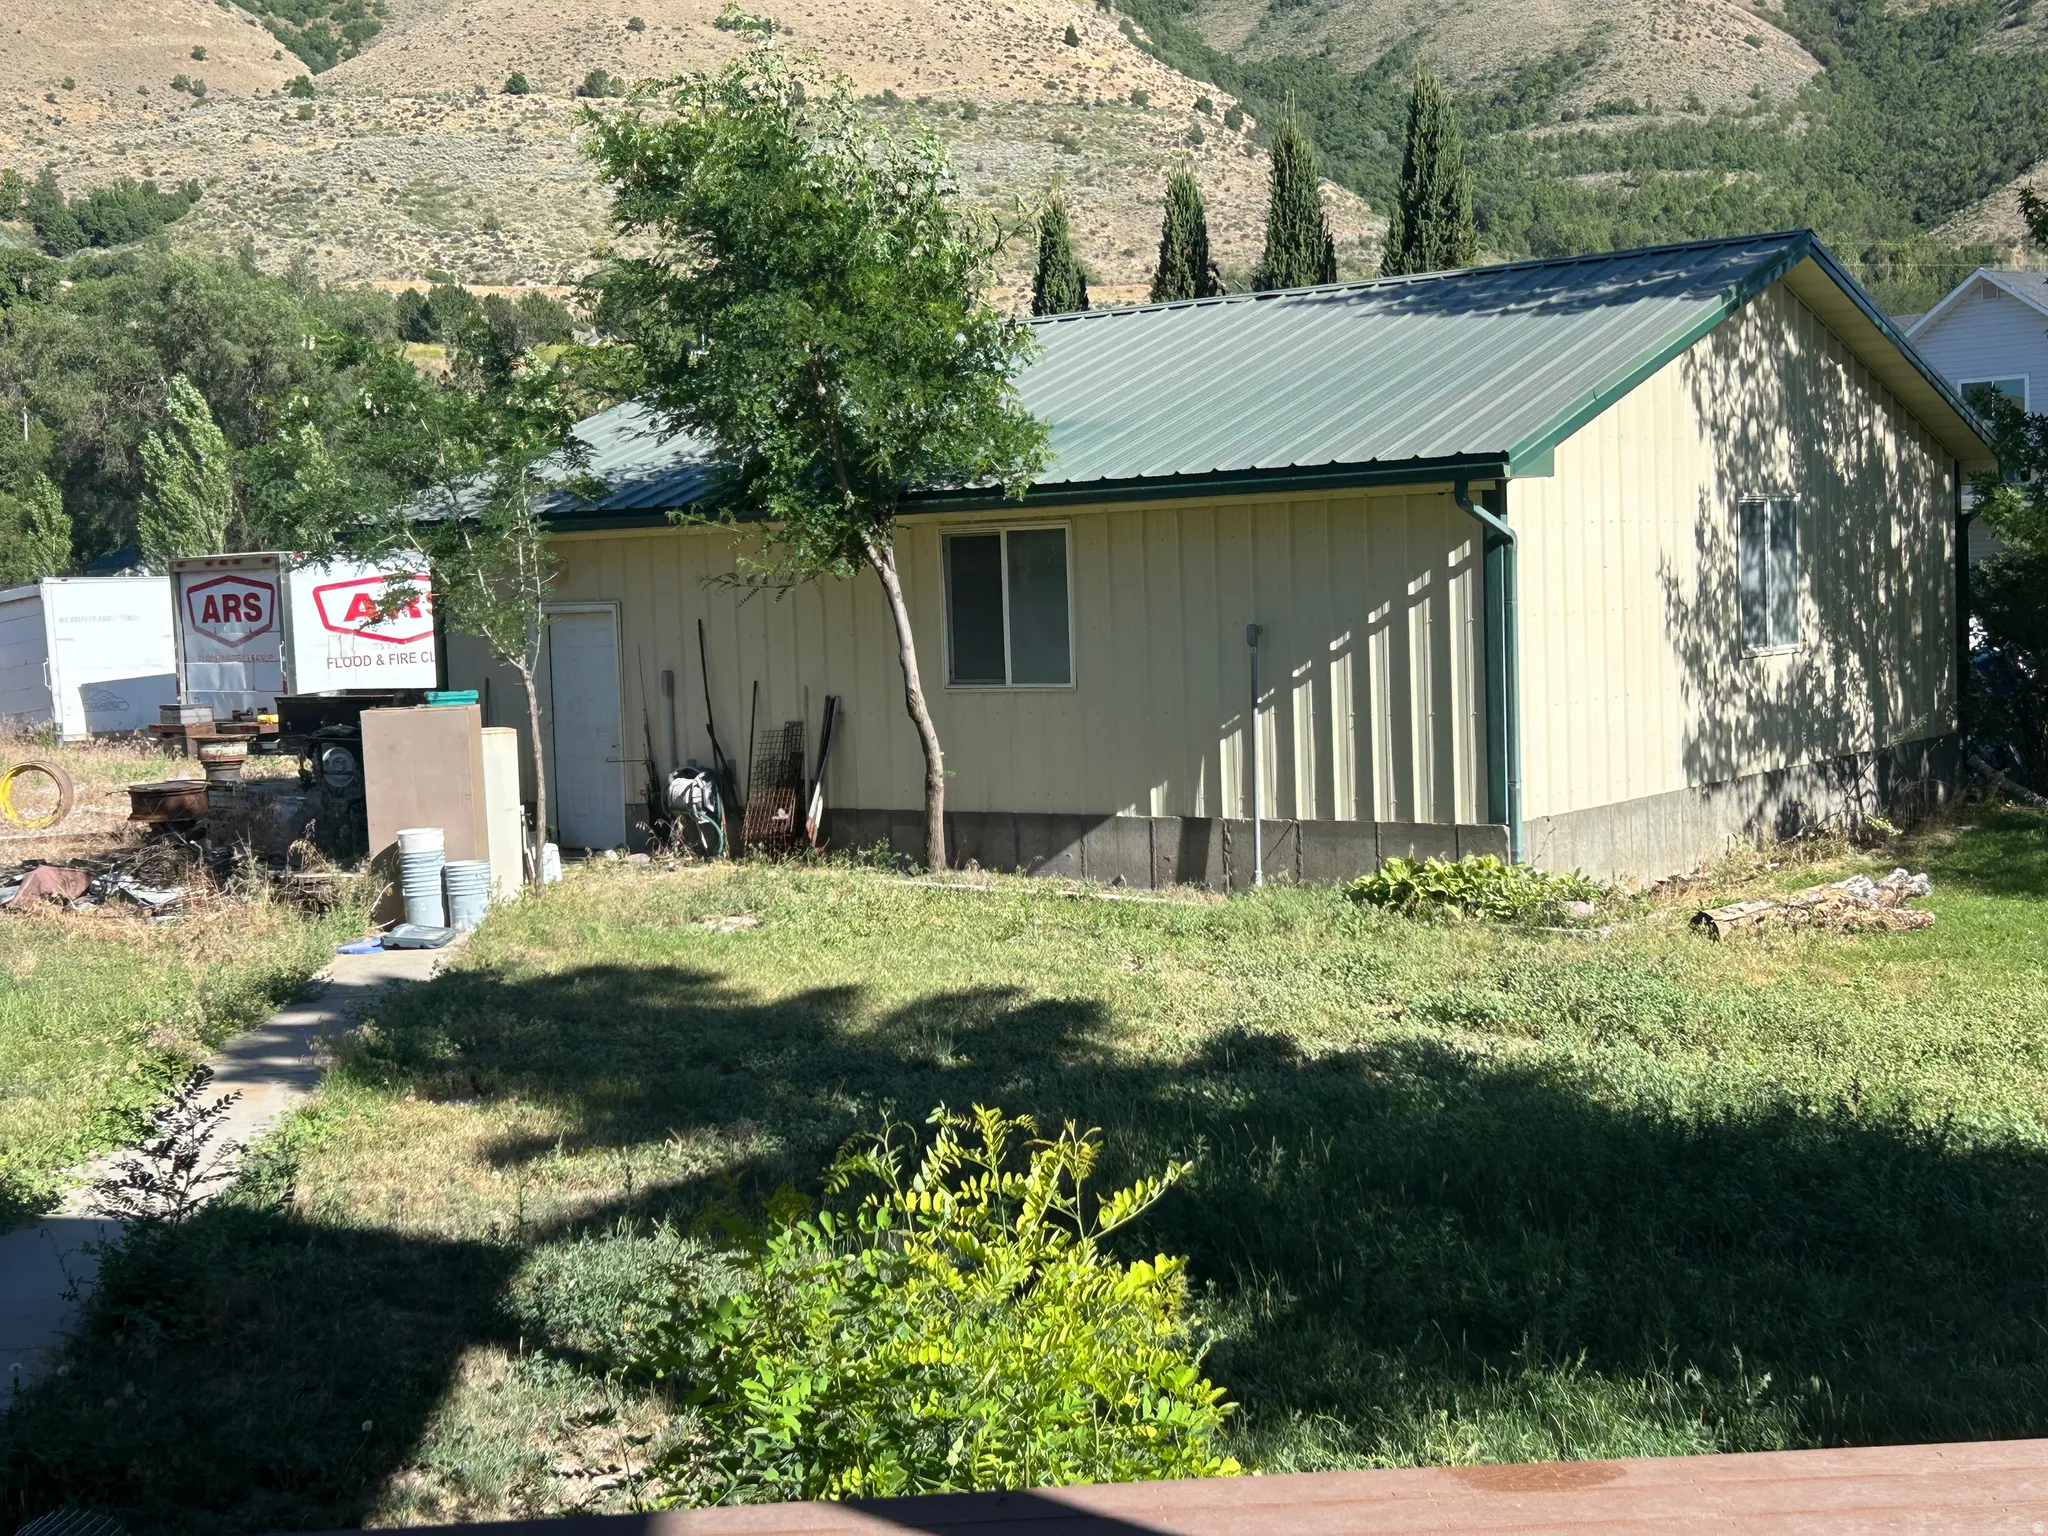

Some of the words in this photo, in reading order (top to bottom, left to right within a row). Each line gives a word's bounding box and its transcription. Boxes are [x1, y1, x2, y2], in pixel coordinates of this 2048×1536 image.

[202, 592, 262, 623] ARS
[327, 655, 372, 669] FLOOD
[376, 654, 385, 666] &
[389, 652, 417, 665] FIRE
